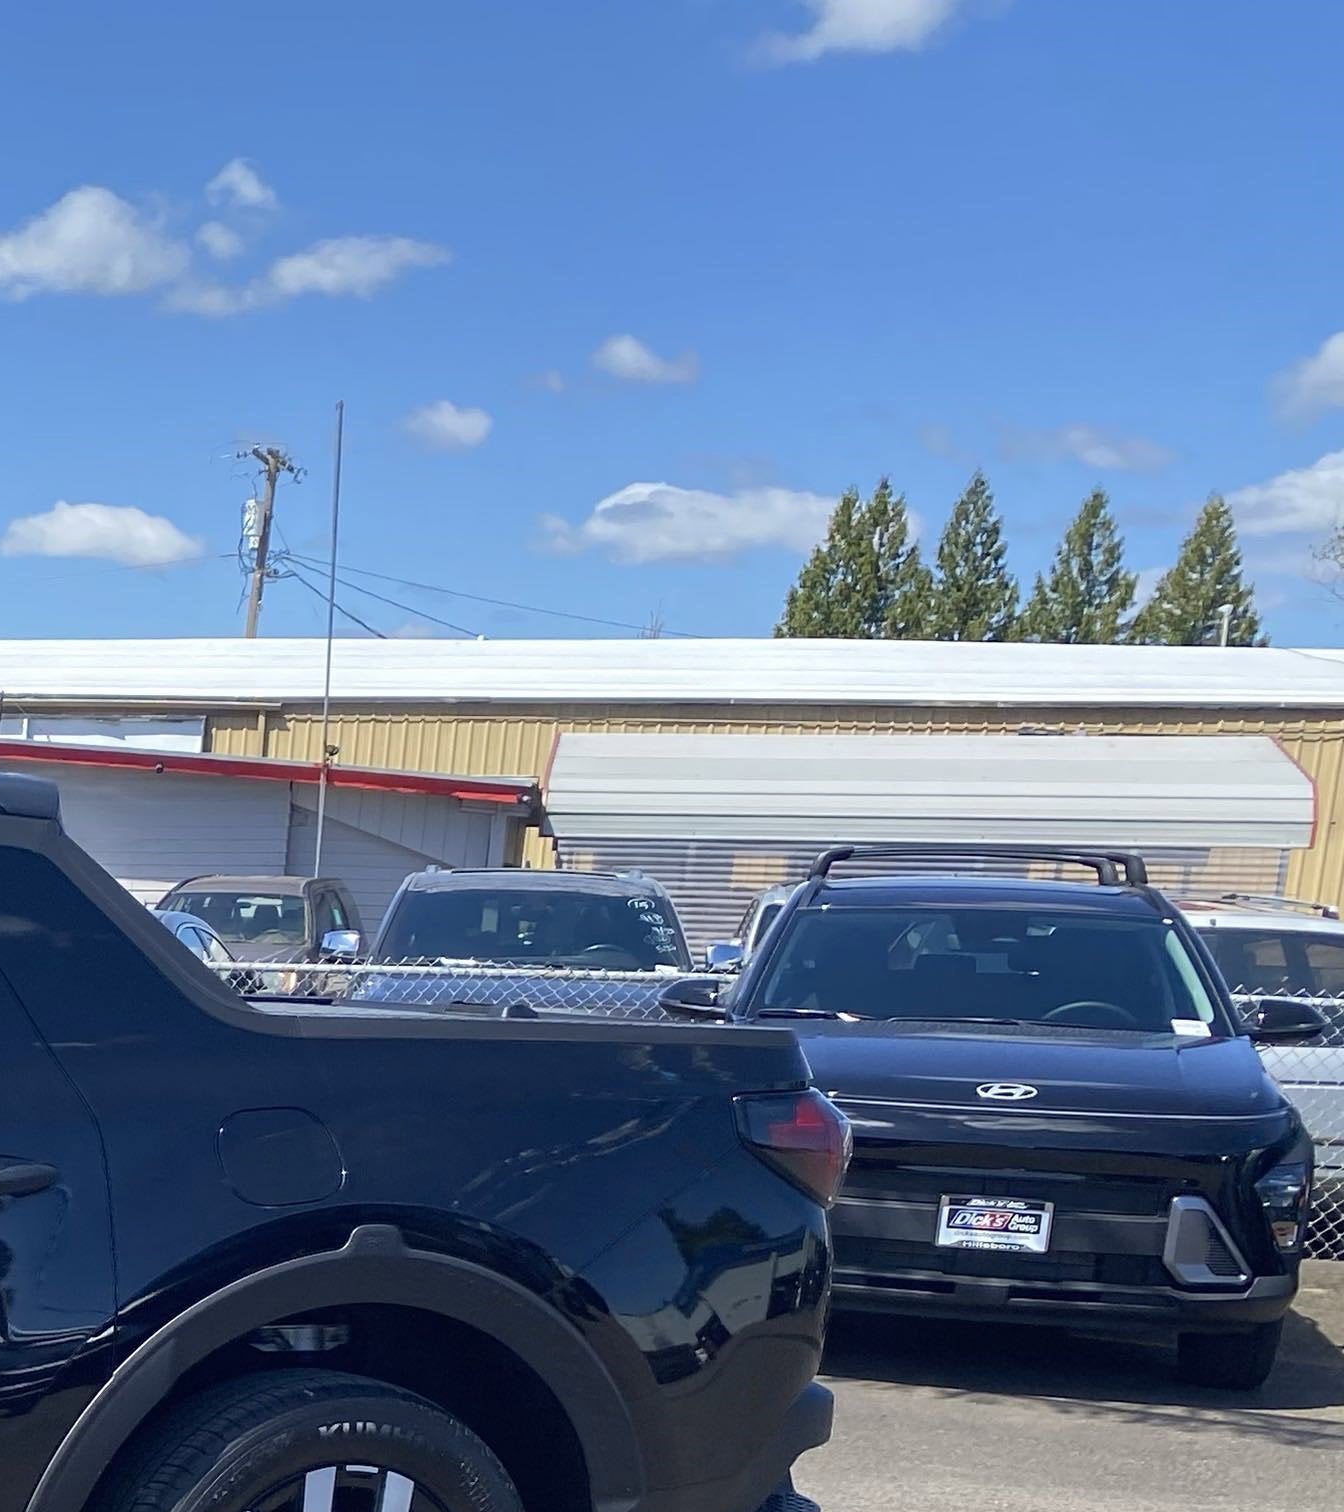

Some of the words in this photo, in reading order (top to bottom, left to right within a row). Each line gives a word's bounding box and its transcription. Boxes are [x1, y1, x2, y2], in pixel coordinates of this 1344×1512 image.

[953, 1211, 1006, 1228] Dick's
[1011, 1213, 1036, 1224] Auto
[1007, 1221, 1039, 1233] Group
